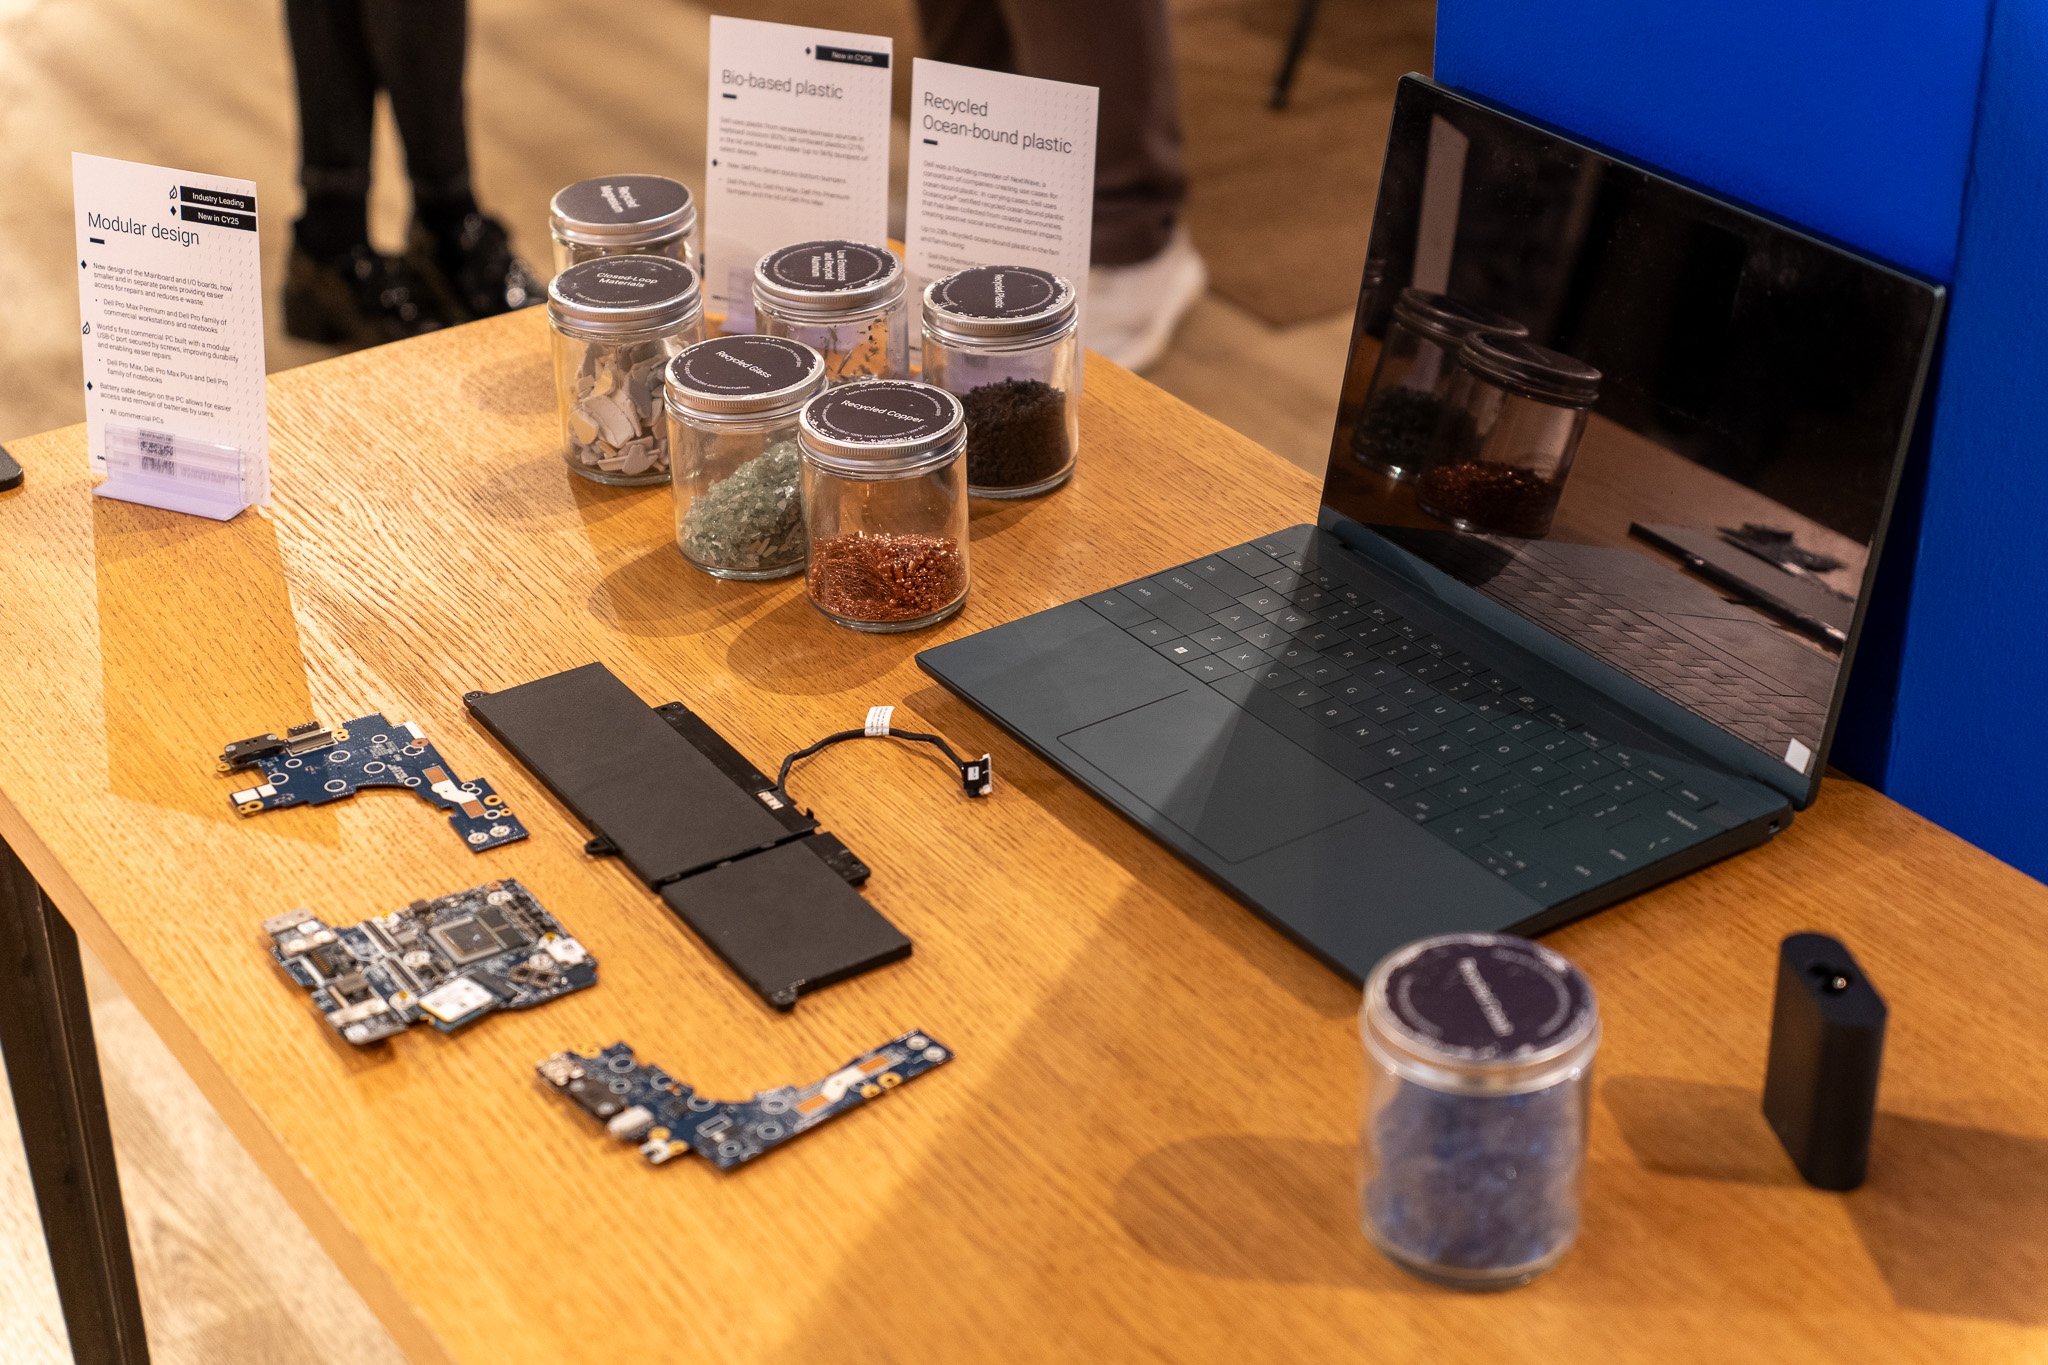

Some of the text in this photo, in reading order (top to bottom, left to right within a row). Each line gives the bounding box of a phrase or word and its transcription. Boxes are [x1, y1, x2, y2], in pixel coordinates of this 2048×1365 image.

[721, 69, 844, 101] Bio-based plastic
[923, 92, 988, 117] Recycled
[923, 115, 1072, 155] Ocean-bound plastic
[192, 191, 244, 208] Industry Leading
[88, 212, 199, 247] Modular design
[197, 211, 239, 226] New in CY25
[93, 262, 105, 270] New
[106, 264, 125, 275] design
[143, 271, 174, 282] Mainboard
[175, 276, 186, 284] and
[197, 280, 219, 291] boards,
[596, 272, 658, 284] Closed-Loop
[598, 278, 646, 288] Materials
[822, 261, 835, 280] Recycled
[992, 273, 1005, 293] Recycled
[93, 271, 114, 280] smaller
[133, 278, 158, 288] separate
[159, 282, 178, 292] panels
[179, 286, 205, 297] providing
[206, 291, 223, 299] easier
[94, 282, 113, 290] access
[123, 286, 143, 296] repairs
[144, 289, 155, 297] and
[156, 291, 178, 301] reduces
[180, 295, 204, 305] e-waste.
[103, 298, 226, 326] Dell Pro Max Premium and Dell Pro family of
[103, 308, 137, 319] commercial
[138, 314, 174, 326] workstations
[188, 323, 217, 334] notebooks
[96, 322, 117, 332] World's
[130, 329, 163, 340] commercial
[174, 336, 186, 344] built
[206, 342, 230, 352] modular
[97, 331, 238, 363] USB-C port secured by screws, improving durability
[97, 341, 171, 361] and enabling easier repairs.
[107, 358, 117, 366] Dell
[129, 363, 142, 371] Max,
[144, 365, 154, 373] Dell
[166, 369, 178, 377] Max
[194, 374, 204, 382] and
[206, 376, 216, 384] Dell
[218, 378, 228, 386] Pro
[107, 368, 124, 377] family
[132, 372, 162, 383] notebooks
[715, 350, 750, 368] Recycled
[749, 364, 772, 378] Glass
[99, 382, 119, 392] Battery
[120, 386, 135, 394] cable
[137, 389, 155, 398] design
[185, 397, 203, 406] allows
[213, 403, 231, 411] easier
[100, 392, 120, 400] access
[133, 397, 155, 406] removal
[163, 402, 188, 413] batteries
[189, 407, 196, 415] by
[118, 410, 151, 421] commercial
[152, 416, 163, 424] PCs
[840, 399, 887, 415] Recycled
[886, 410, 925, 423] Copper
